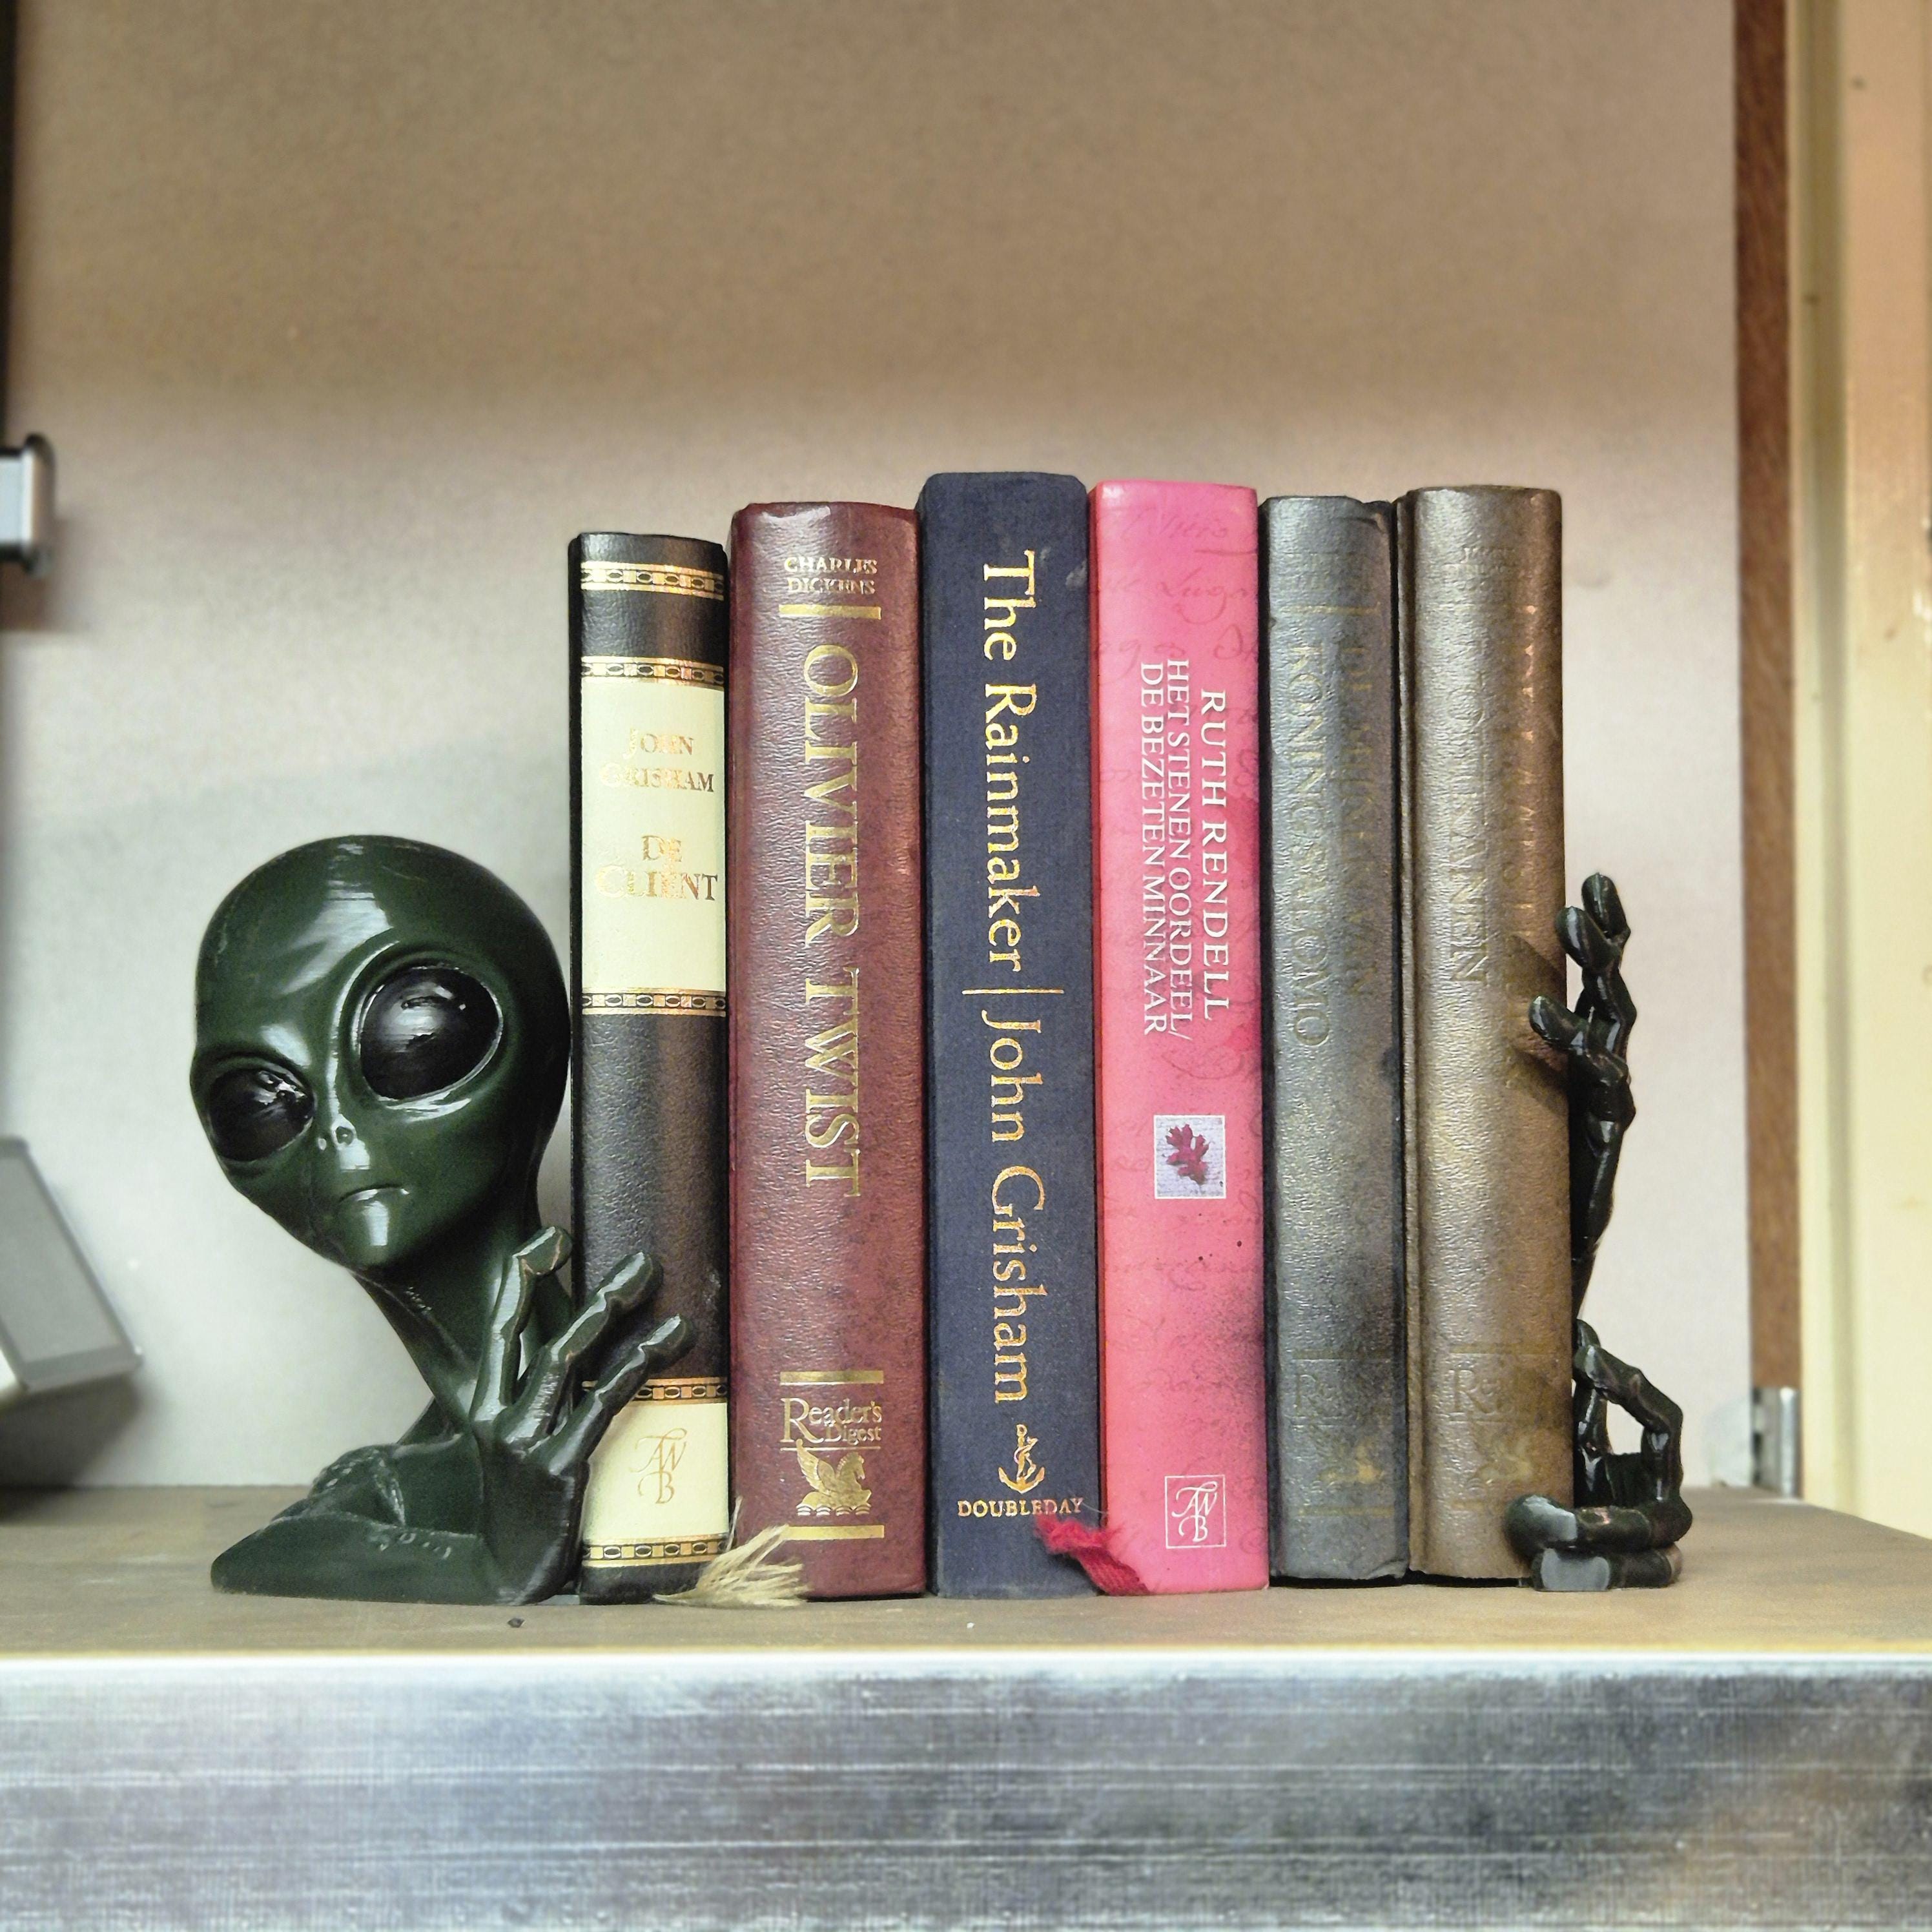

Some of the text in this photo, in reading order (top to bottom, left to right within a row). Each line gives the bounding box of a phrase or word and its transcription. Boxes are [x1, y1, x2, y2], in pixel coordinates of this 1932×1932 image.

[783, 556, 878, 575] CHARLES
[1167, 659, 1190, 726] HET
[1167, 731, 1191, 861] STENEN
[1140, 662, 1167, 1036] DE BEZETEN MINNAAR
[1200, 688, 1229, 1021] RUTH RENDELL
[803, 644, 861, 1198] OLIVIER TWIST
[981, 549, 1048, 1404] The Rainmaker John Grisham
[779, 1397, 883, 1444] Reader's
[823, 1424, 882, 1446] Digest
[957, 1497, 1084, 1517] DOUBLEDAY
